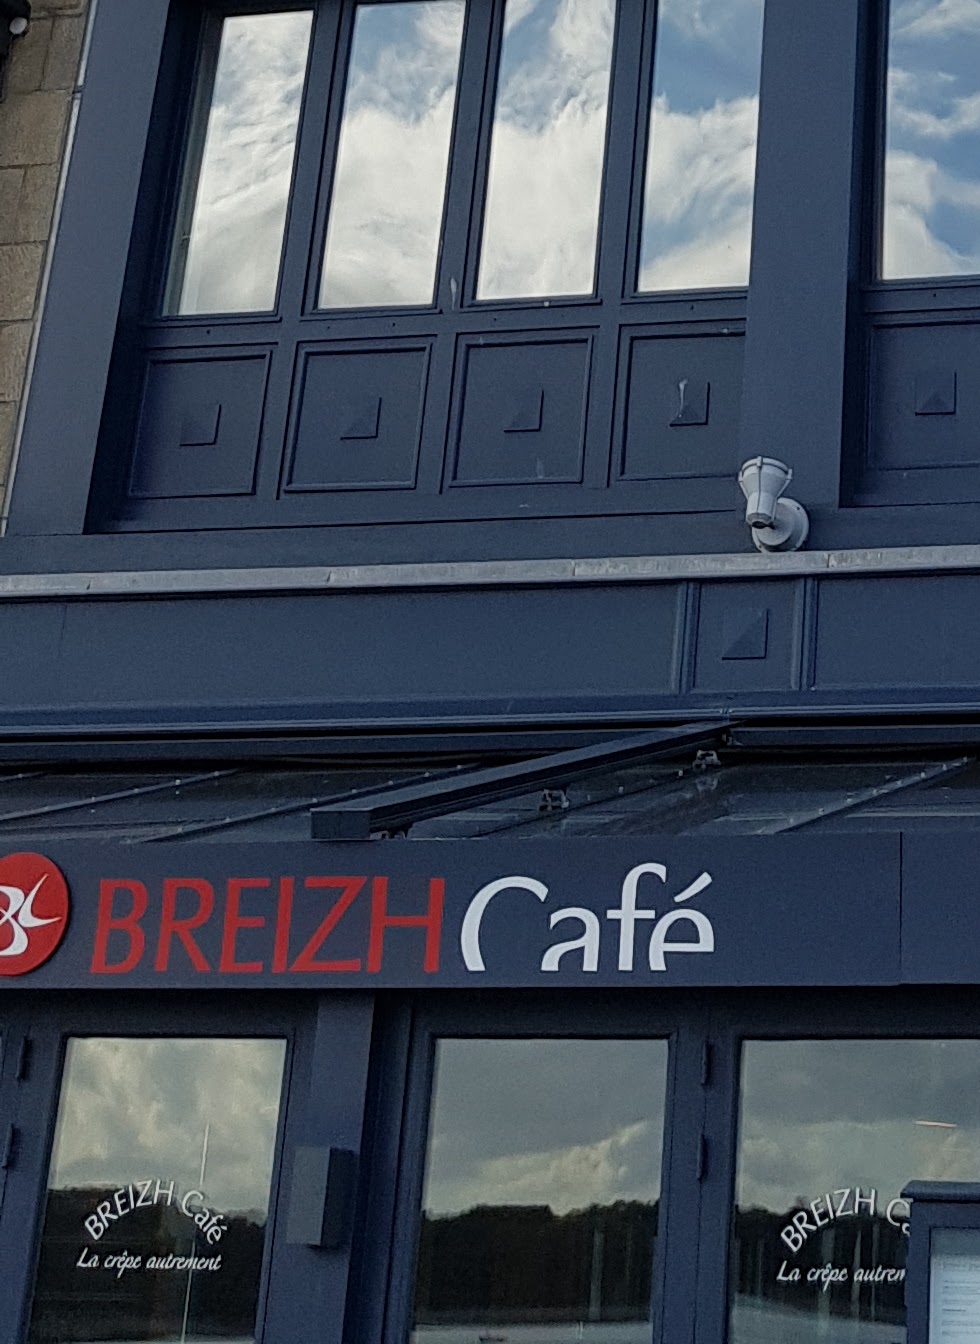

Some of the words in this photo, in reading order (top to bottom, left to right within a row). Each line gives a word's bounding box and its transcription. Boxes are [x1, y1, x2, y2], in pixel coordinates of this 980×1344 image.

[90, 875, 446, 975] BREIZH
[460, 862, 715, 973] Café
[84, 1178, 176, 1241] BREIZH
[181, 1189, 228, 1245] Café
[780, 1186, 877, 1254] BREIZH
[76, 1246, 100, 1268] La
[103, 1249, 142, 1279] crêpe
[145, 1252, 222, 1271] autrement
[776, 1260, 801, 1281] La
[806, 1262, 849, 1293] crêpe
